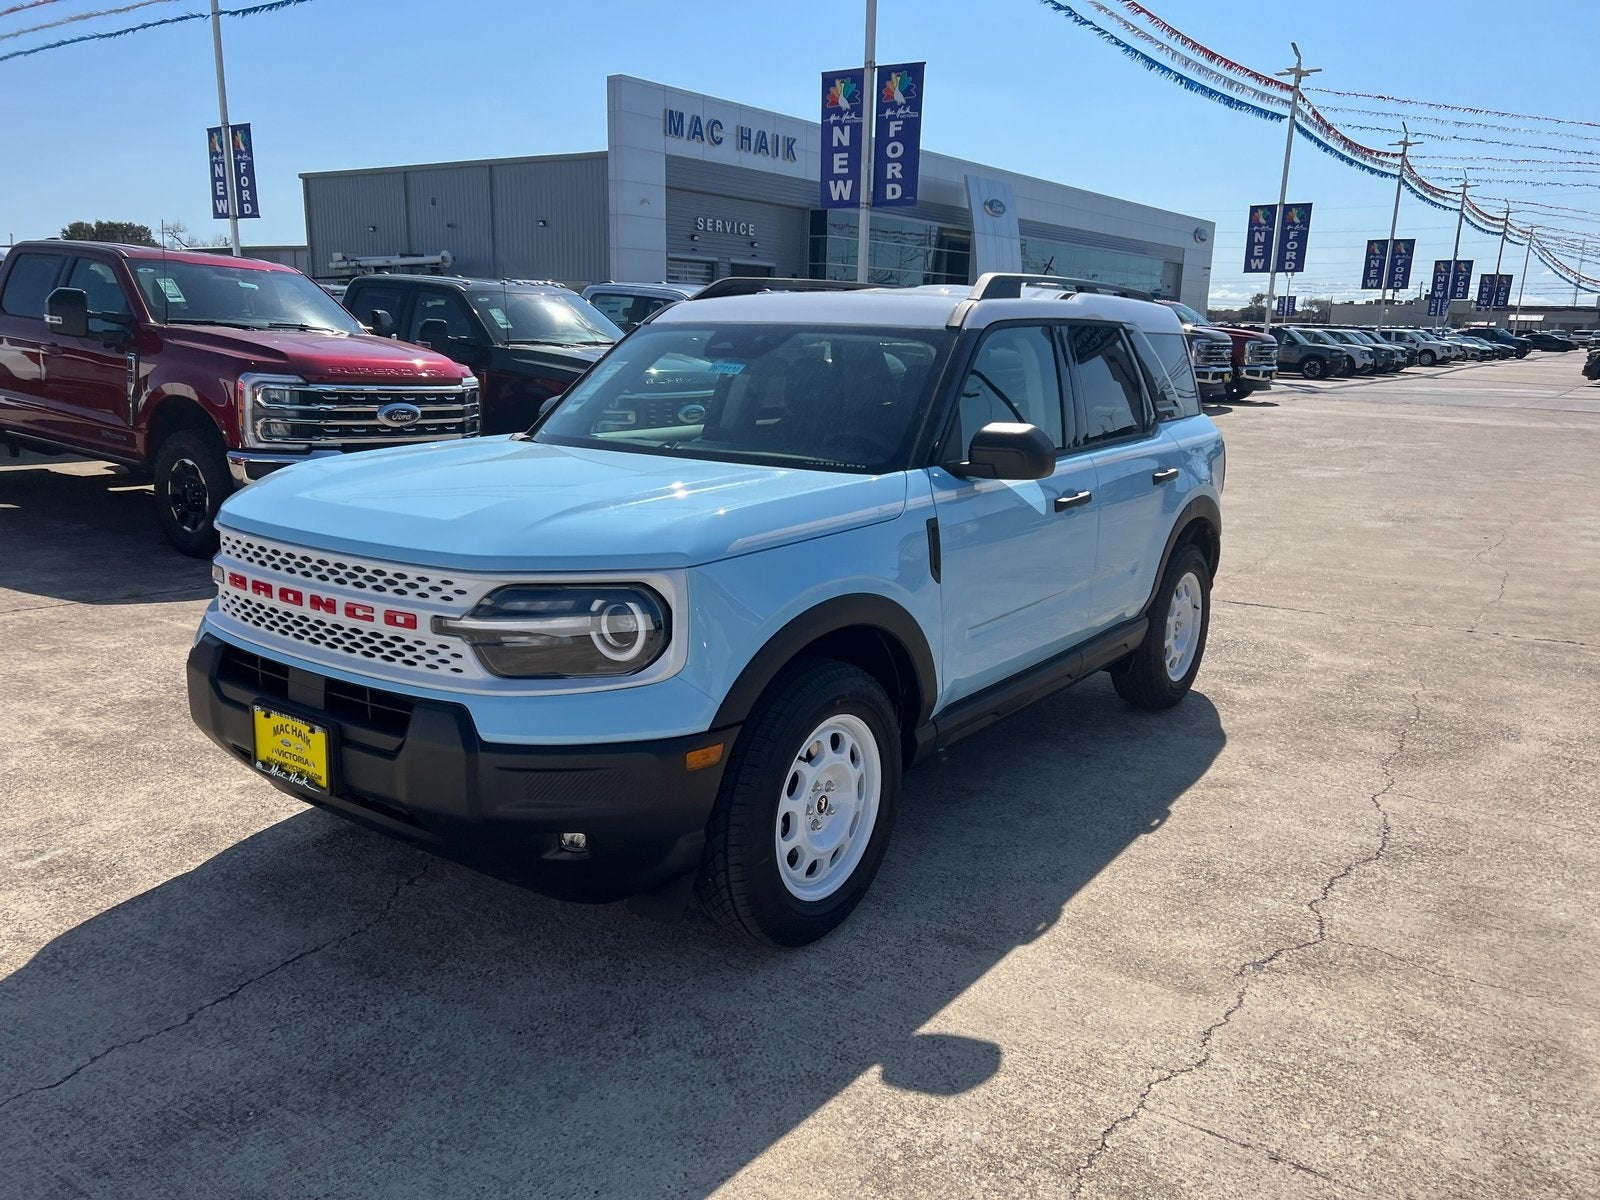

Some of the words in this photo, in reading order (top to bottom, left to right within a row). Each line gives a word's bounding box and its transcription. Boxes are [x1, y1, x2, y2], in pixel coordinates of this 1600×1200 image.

[665, 108, 724, 146] MAC
[737, 125, 797, 161] HAIK
[829, 125, 853, 201] NEW
[886, 121, 904, 200] FORD
[214, 163, 228, 214] NEW
[240, 162, 252, 214] FORD
[696, 216, 755, 236] SERVICE
[1250, 231, 1266, 270] NEW
[1284, 231, 1299, 270] FORD
[1366, 259, 1380, 288] NEW
[1393, 259, 1405, 288] FORD
[1434, 275, 1445, 298] NEW
[1456, 275, 1465, 298] FORD
[328, 366, 400, 377] SUPER
[400, 367, 446, 378] DUTY
[391, 409, 412, 421] Ford
[228, 571, 418, 631] BRONCO
[272, 723, 291, 738] MAC
[291, 724, 313, 750] HAIK
[270, 764, 289, 780] Mac
[288, 771, 320, 793] Haik
